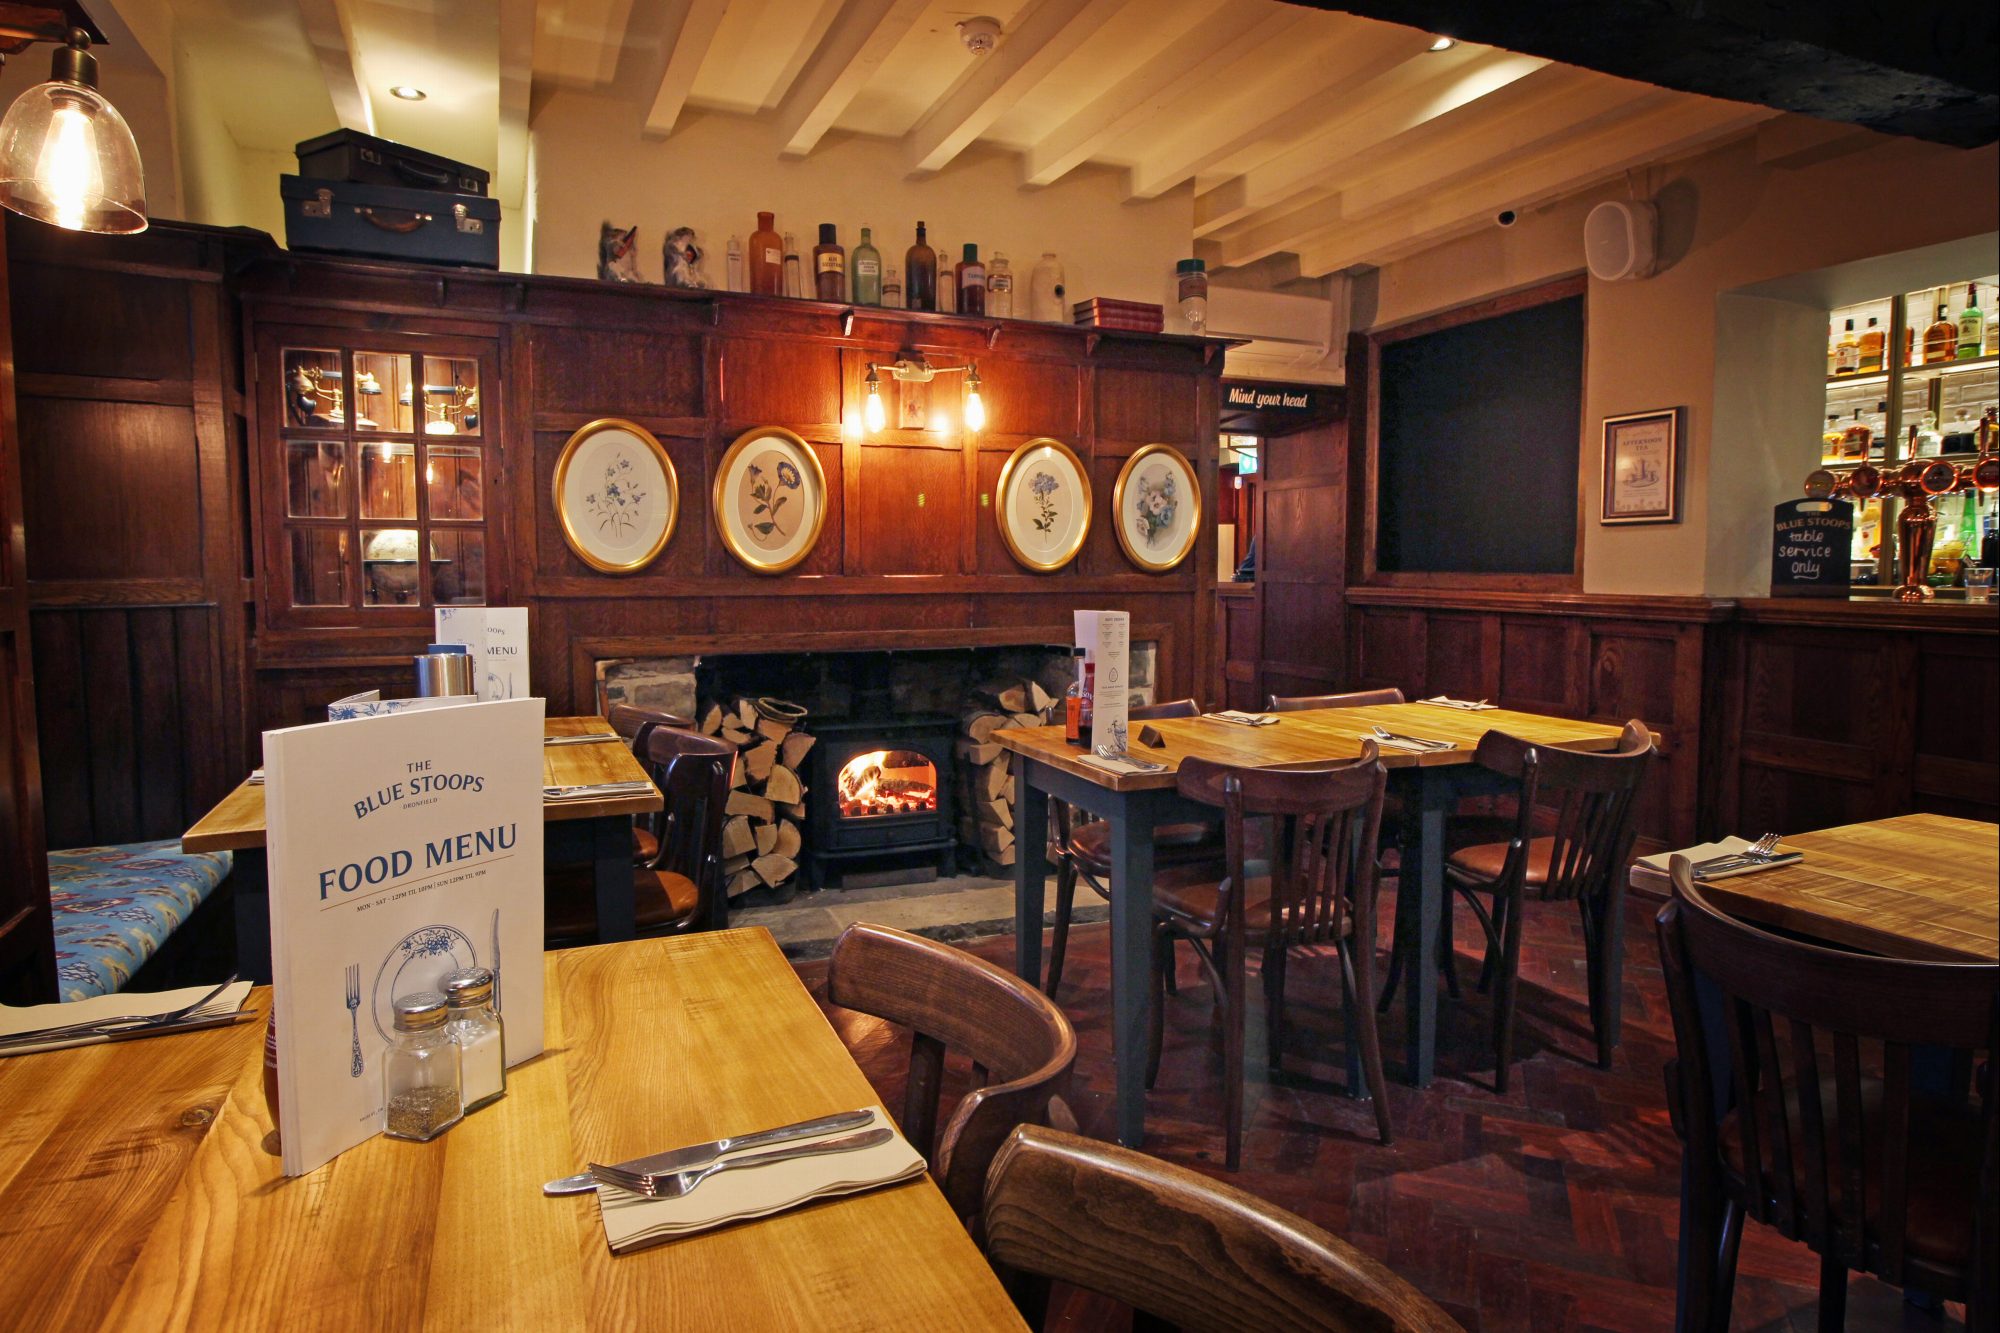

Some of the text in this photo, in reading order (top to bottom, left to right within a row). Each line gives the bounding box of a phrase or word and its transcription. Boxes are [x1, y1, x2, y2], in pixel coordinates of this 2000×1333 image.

[1229, 388, 1307, 409] Mind your head
[1776, 519, 1805, 531] BLUE
[1807, 517, 1851, 529] STOOPS
[1789, 529, 1824, 542] table
[1778, 545, 1831, 557] service
[407, 760, 432, 773] THE
[353, 774, 485, 819] BLUE STOOPS
[403, 798, 438, 809] DRONFIELD
[319, 823, 517, 900] FOOD MENU
[356, 903, 371, 912] MON
[375, 898, 386, 906] SAT
[392, 892, 407, 901] 12PM
[418, 884, 433, 893] 10PM
[449, 876, 464, 884] 12PM
